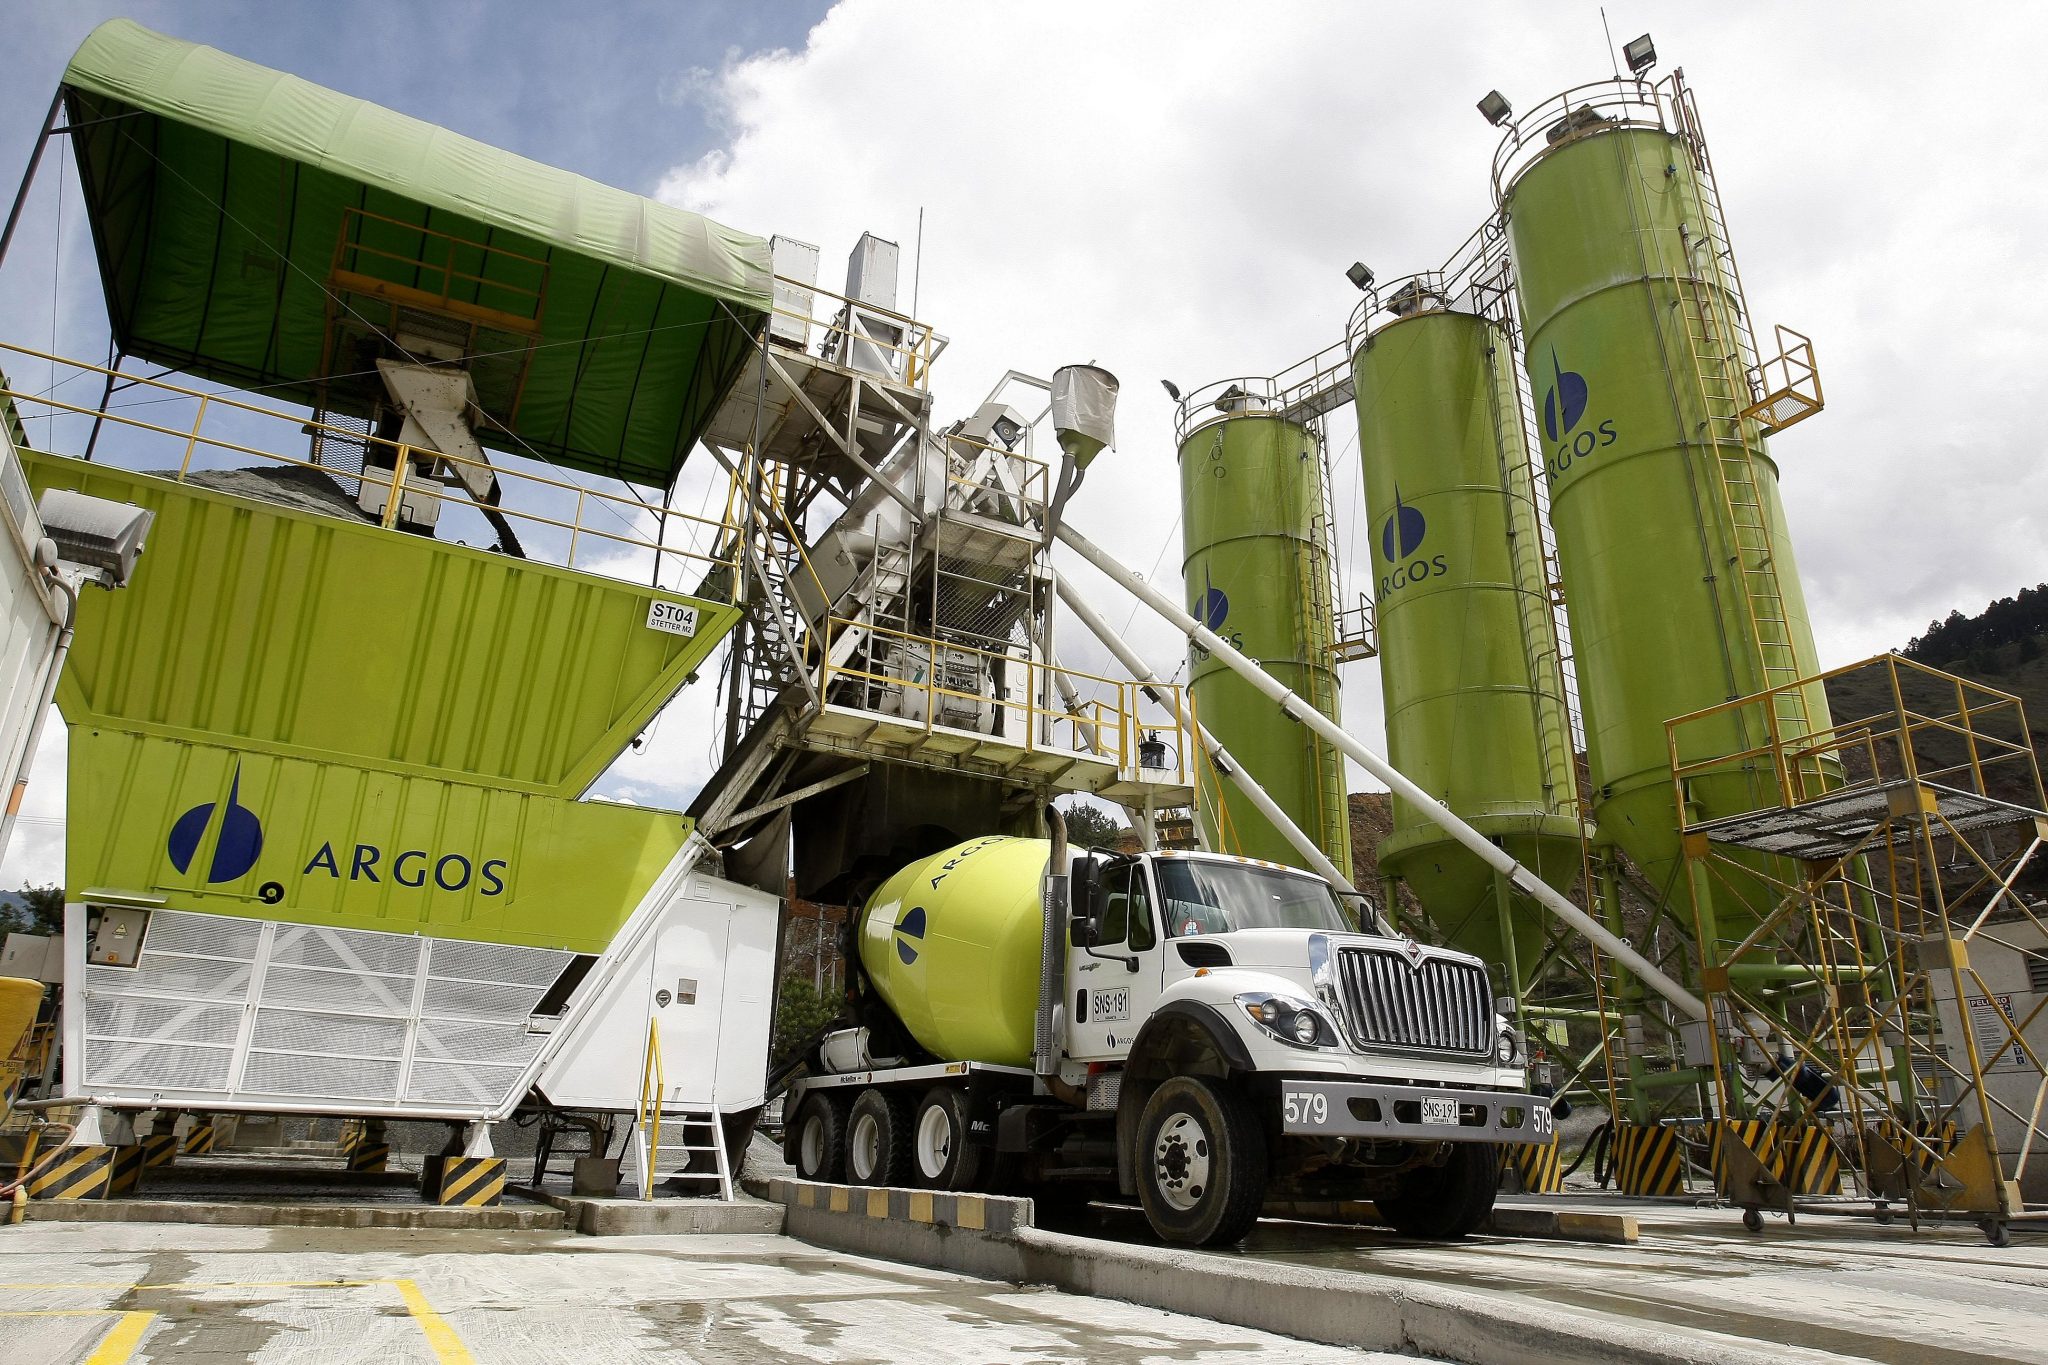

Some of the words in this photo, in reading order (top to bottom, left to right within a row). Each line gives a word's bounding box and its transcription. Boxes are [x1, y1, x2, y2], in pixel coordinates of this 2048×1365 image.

[1548, 419, 1617, 486] RGOS
[651, 618, 681, 632] STETTER
[682, 626, 692, 634] M2
[653, 603, 693, 625] ST04
[303, 840, 507, 897] ARGOS
[931, 837, 1012, 890] ARGO
[1284, 1092, 1328, 1125] 579
[1533, 1105, 1552, 1135] 579
